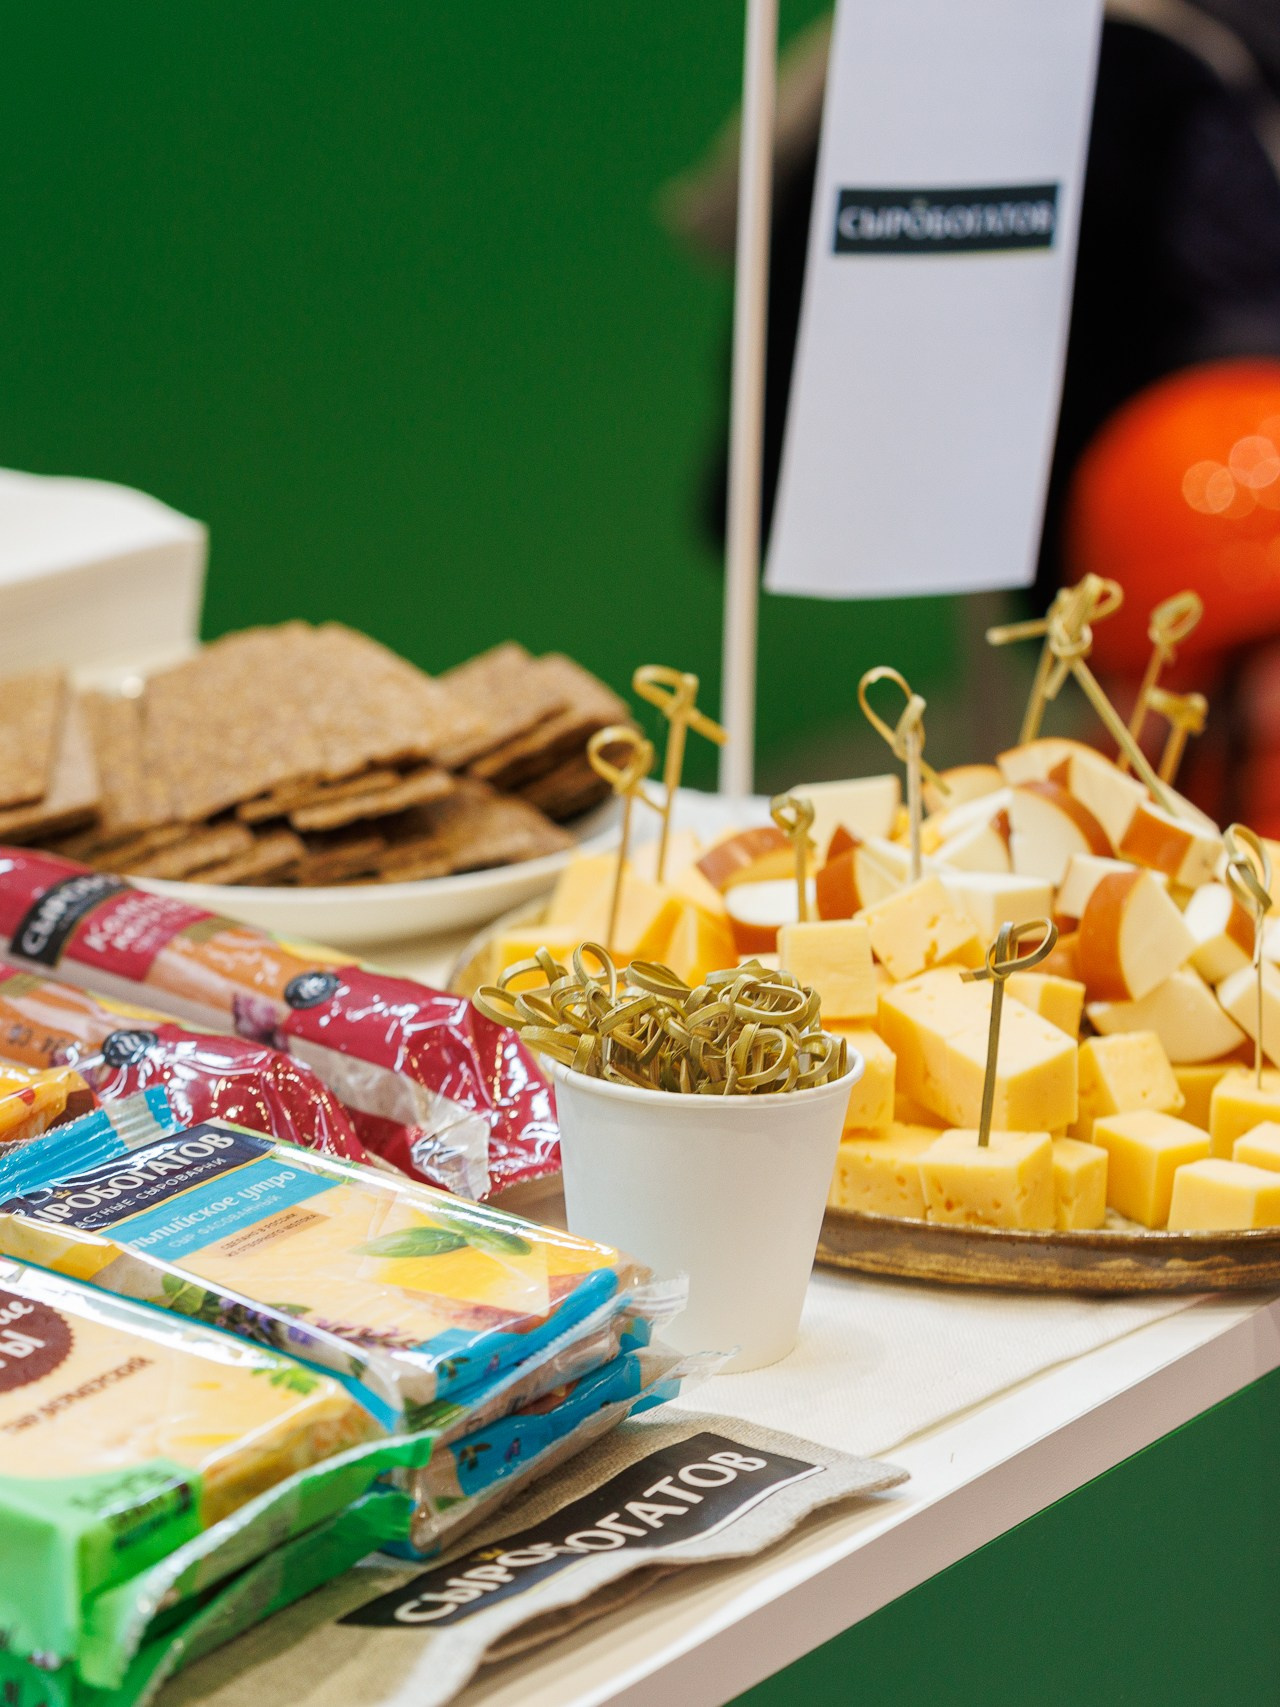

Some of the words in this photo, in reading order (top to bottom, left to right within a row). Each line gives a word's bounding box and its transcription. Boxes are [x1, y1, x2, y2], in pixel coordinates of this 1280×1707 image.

[33, 1133, 235, 1224] РОБОГАТОВ
[74, 1198, 136, 1229] АСТНЫЕ
[136, 1157, 227, 1200] СЫРОВАРНИ
[128, 1195, 240, 1251] льпийское
[238, 1171, 297, 1202] утро
